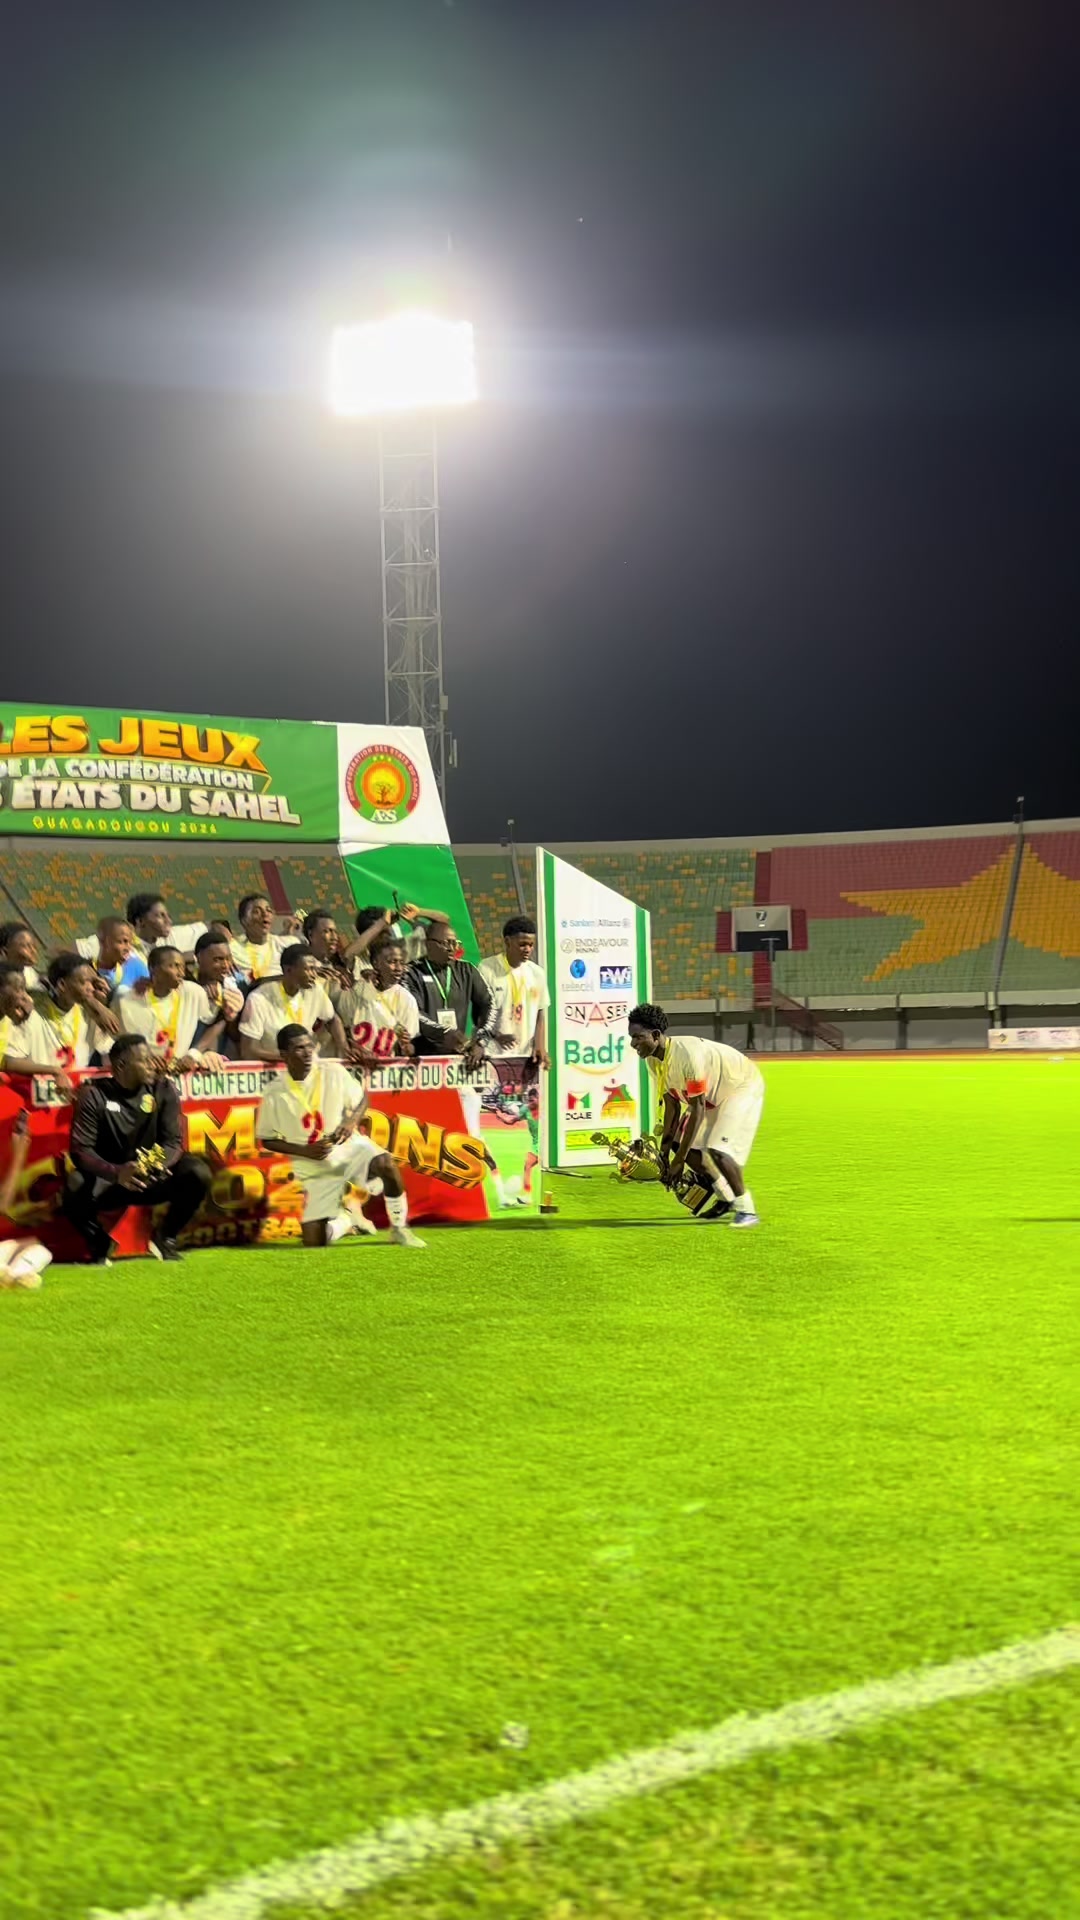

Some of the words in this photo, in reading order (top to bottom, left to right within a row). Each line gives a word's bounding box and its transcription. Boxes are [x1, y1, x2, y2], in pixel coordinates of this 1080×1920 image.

[98, 717, 268, 772] JEUX
[28, 756, 60, 777] LA
[130, 782, 182, 813] DU
[189, 787, 301, 824] SAHEL
[575, 938, 629, 947] ENDEAVOUR
[353, 1021, 395, 1057] 20
[564, 1033, 625, 1065] Badf
[421, 1064, 440, 1087] DU
